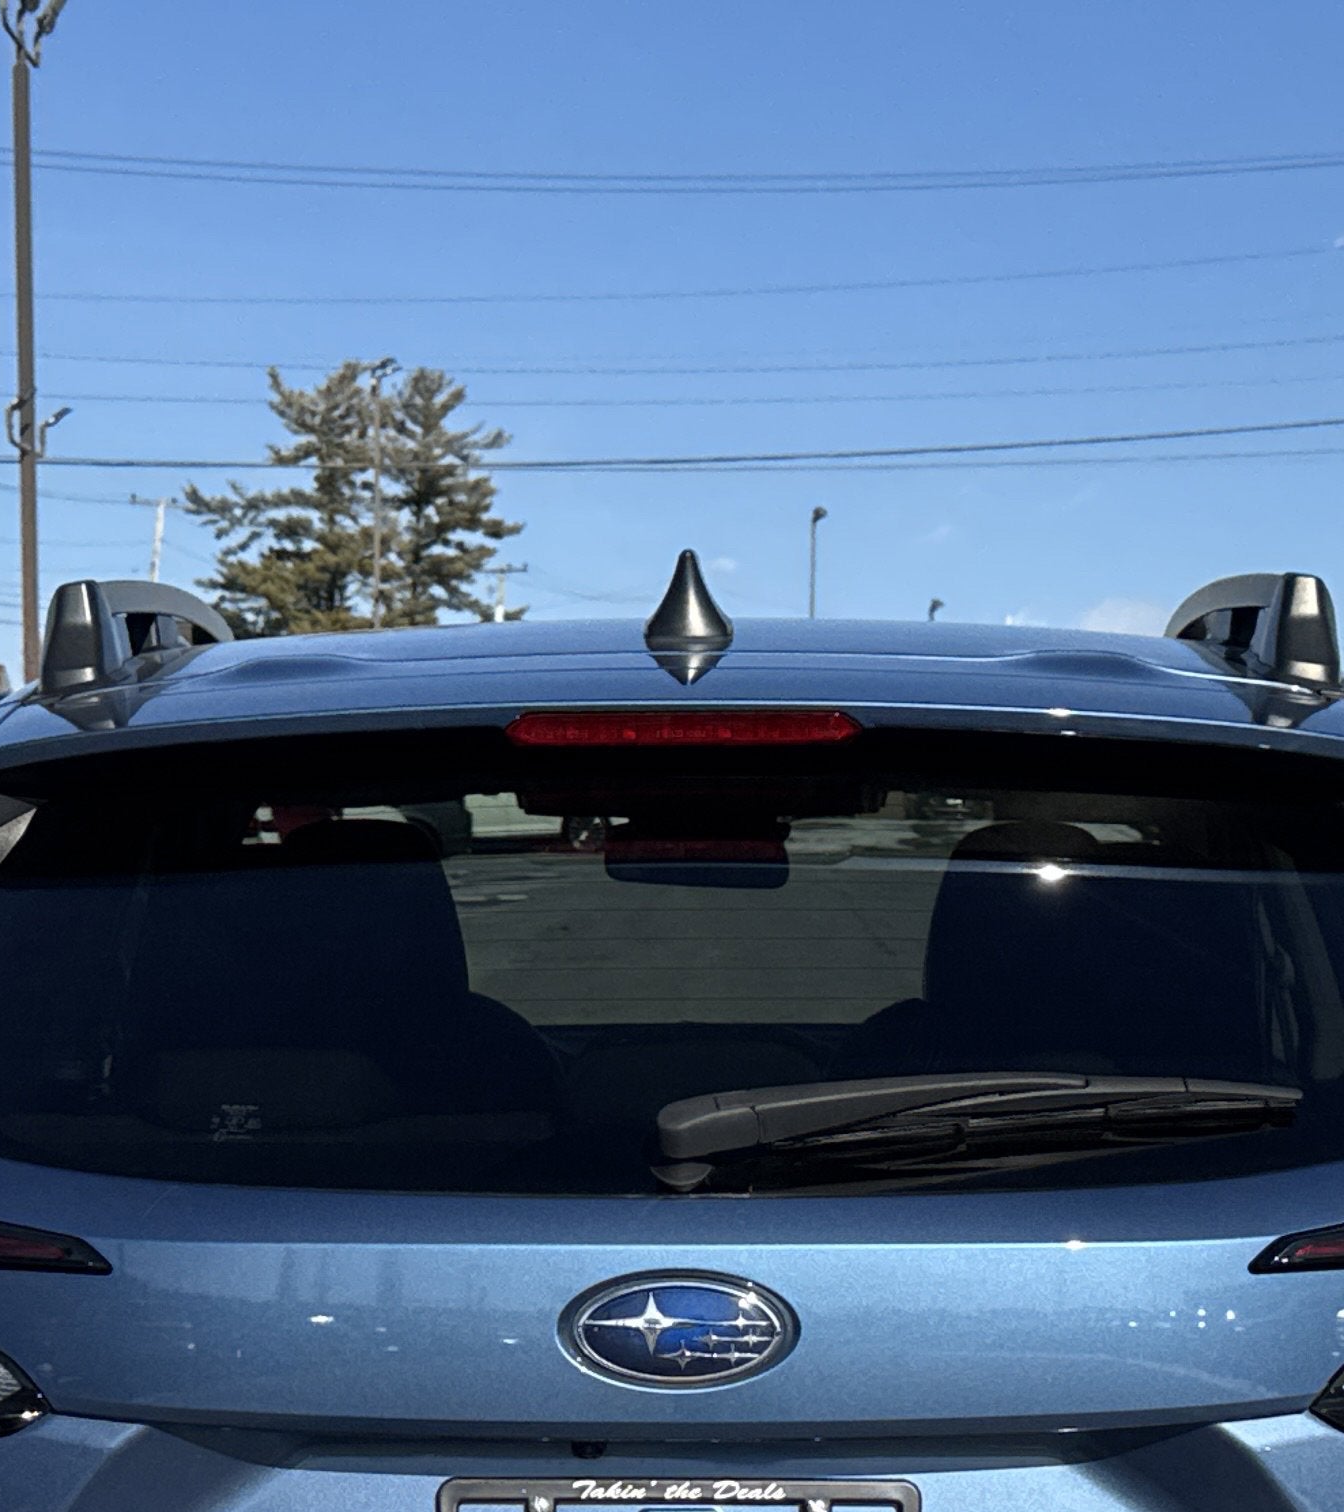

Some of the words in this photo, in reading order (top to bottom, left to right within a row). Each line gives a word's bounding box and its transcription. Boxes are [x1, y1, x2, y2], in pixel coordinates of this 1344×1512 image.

[572, 1480, 657, 1500] Takin'
[663, 1481, 702, 1500] the
[712, 1480, 787, 1500] Deals
